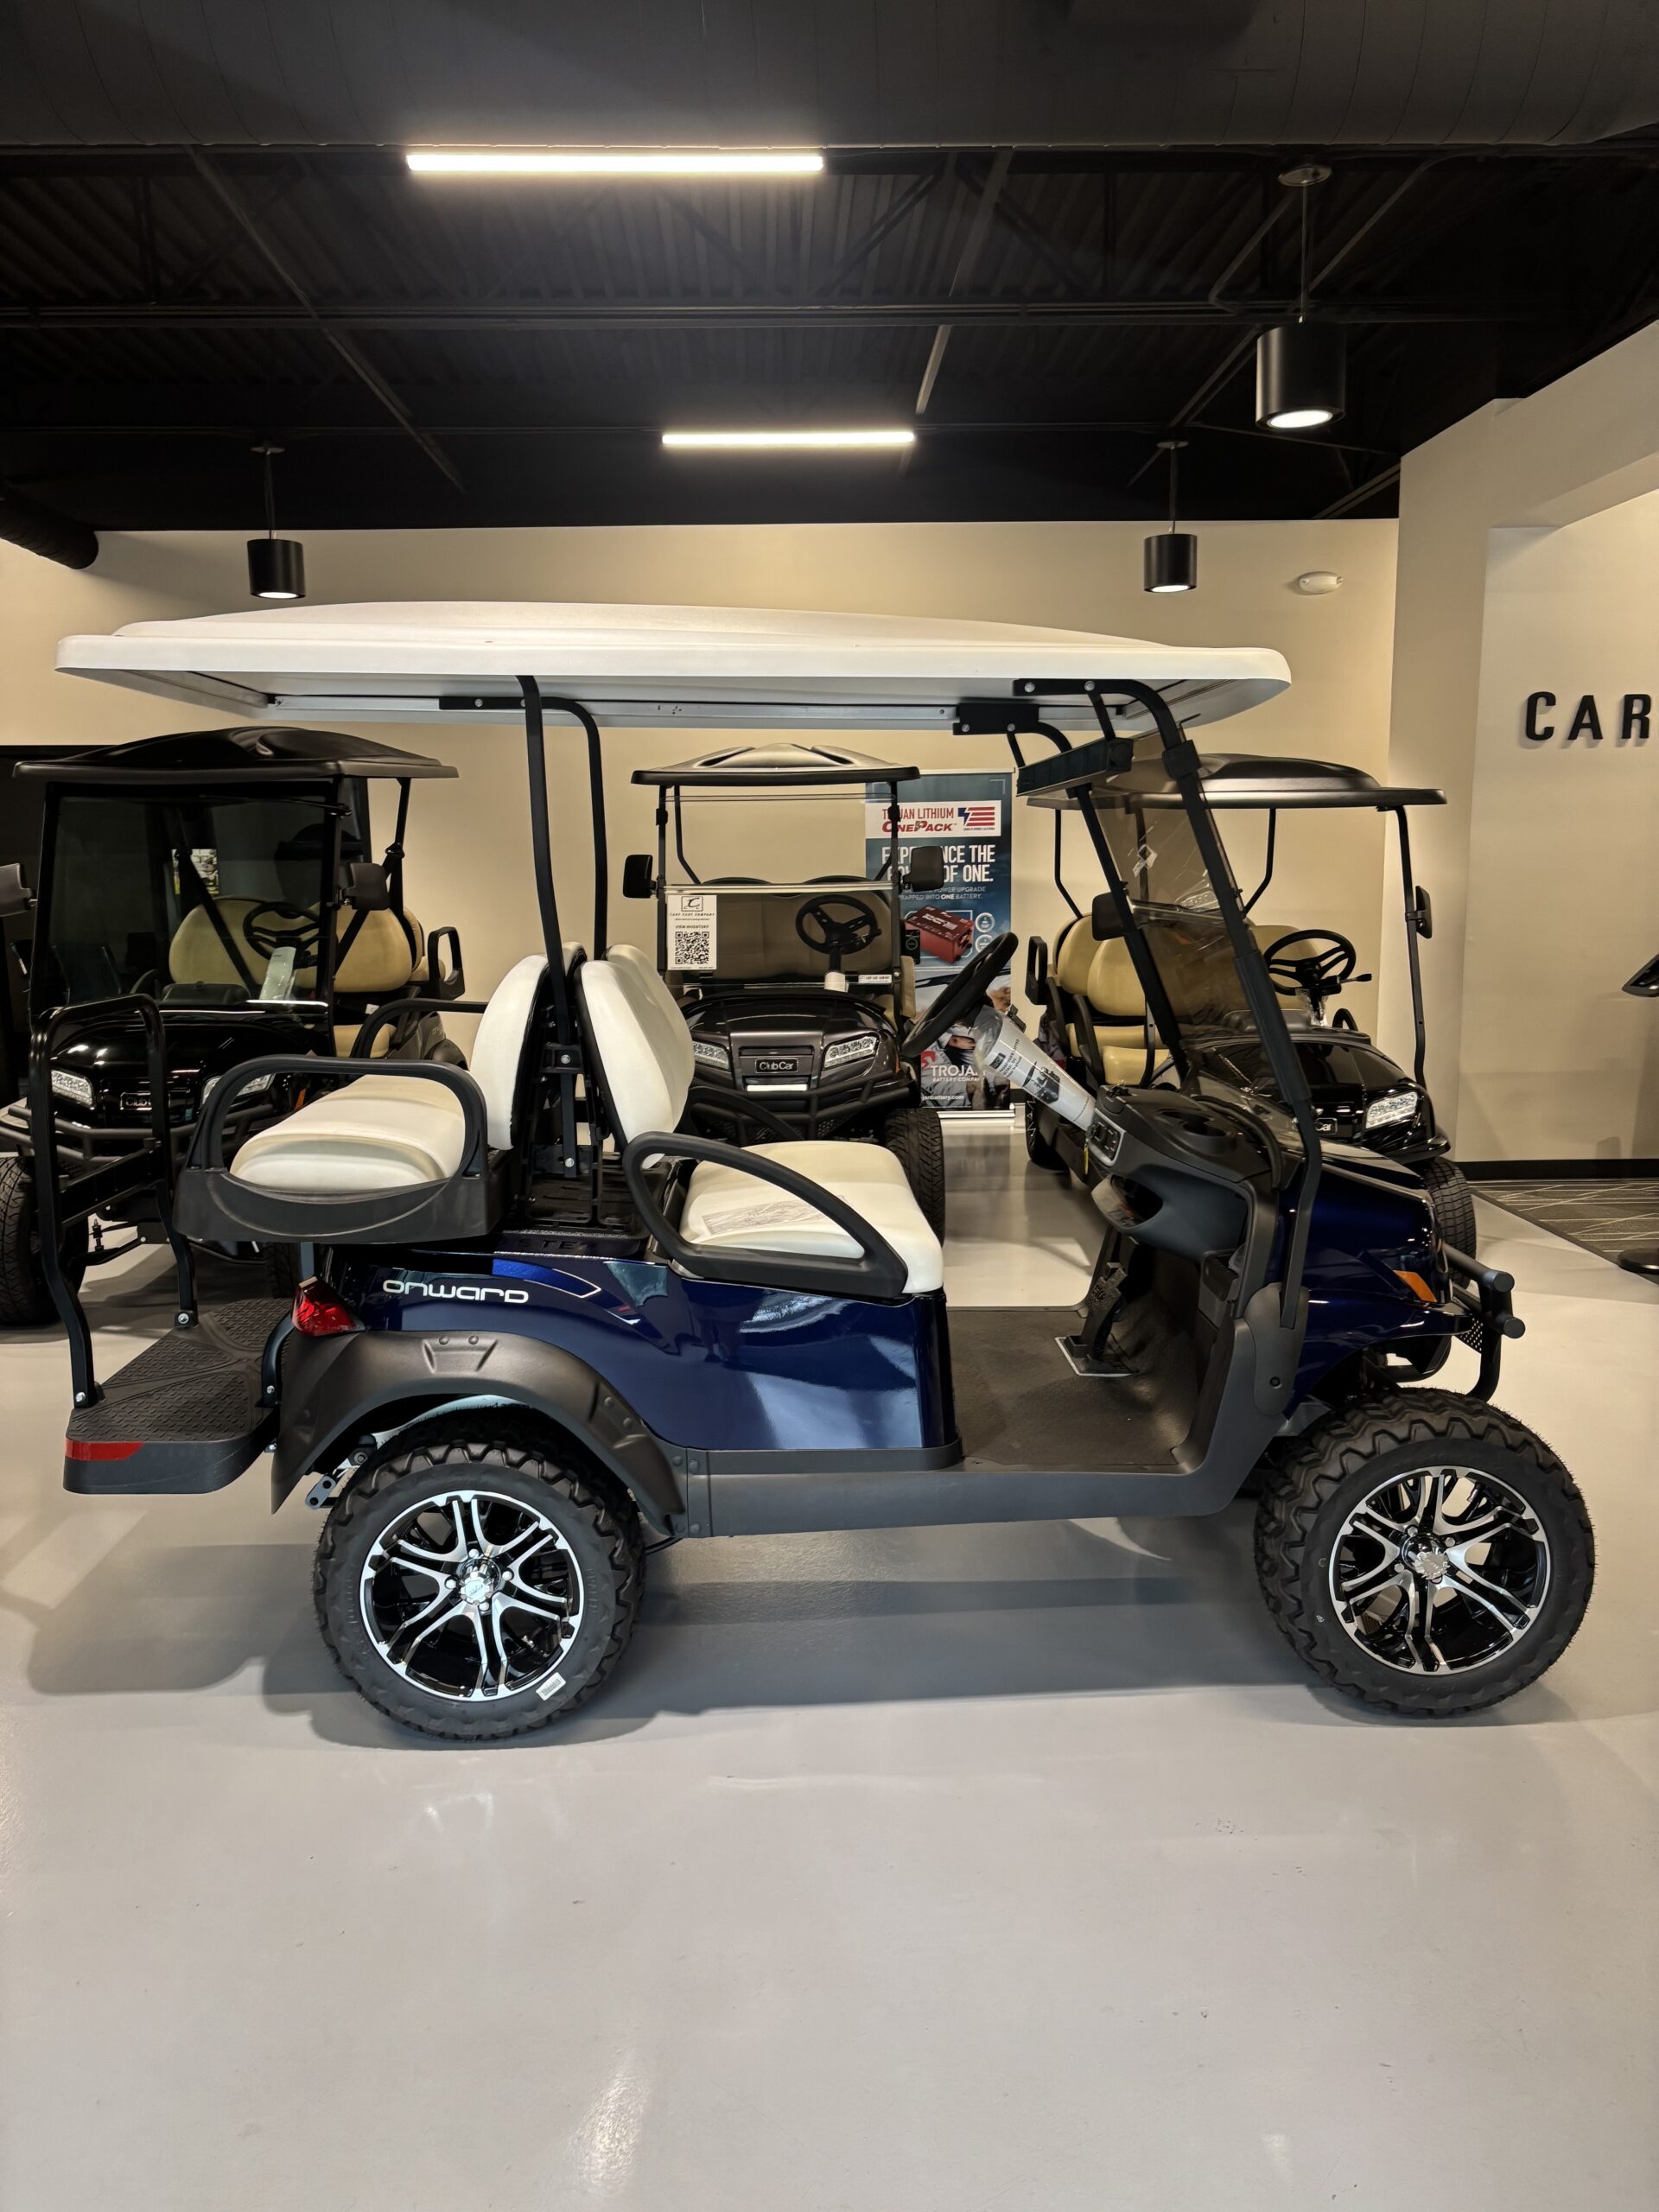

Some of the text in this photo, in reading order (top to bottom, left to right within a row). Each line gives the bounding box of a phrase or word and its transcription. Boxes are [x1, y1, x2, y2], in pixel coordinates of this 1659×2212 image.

[1526, 691, 1652, 741] CAR
[918, 807, 954, 819] LITHIUM
[969, 844, 996, 863] THE
[944, 864, 994, 883] OF ONE.
